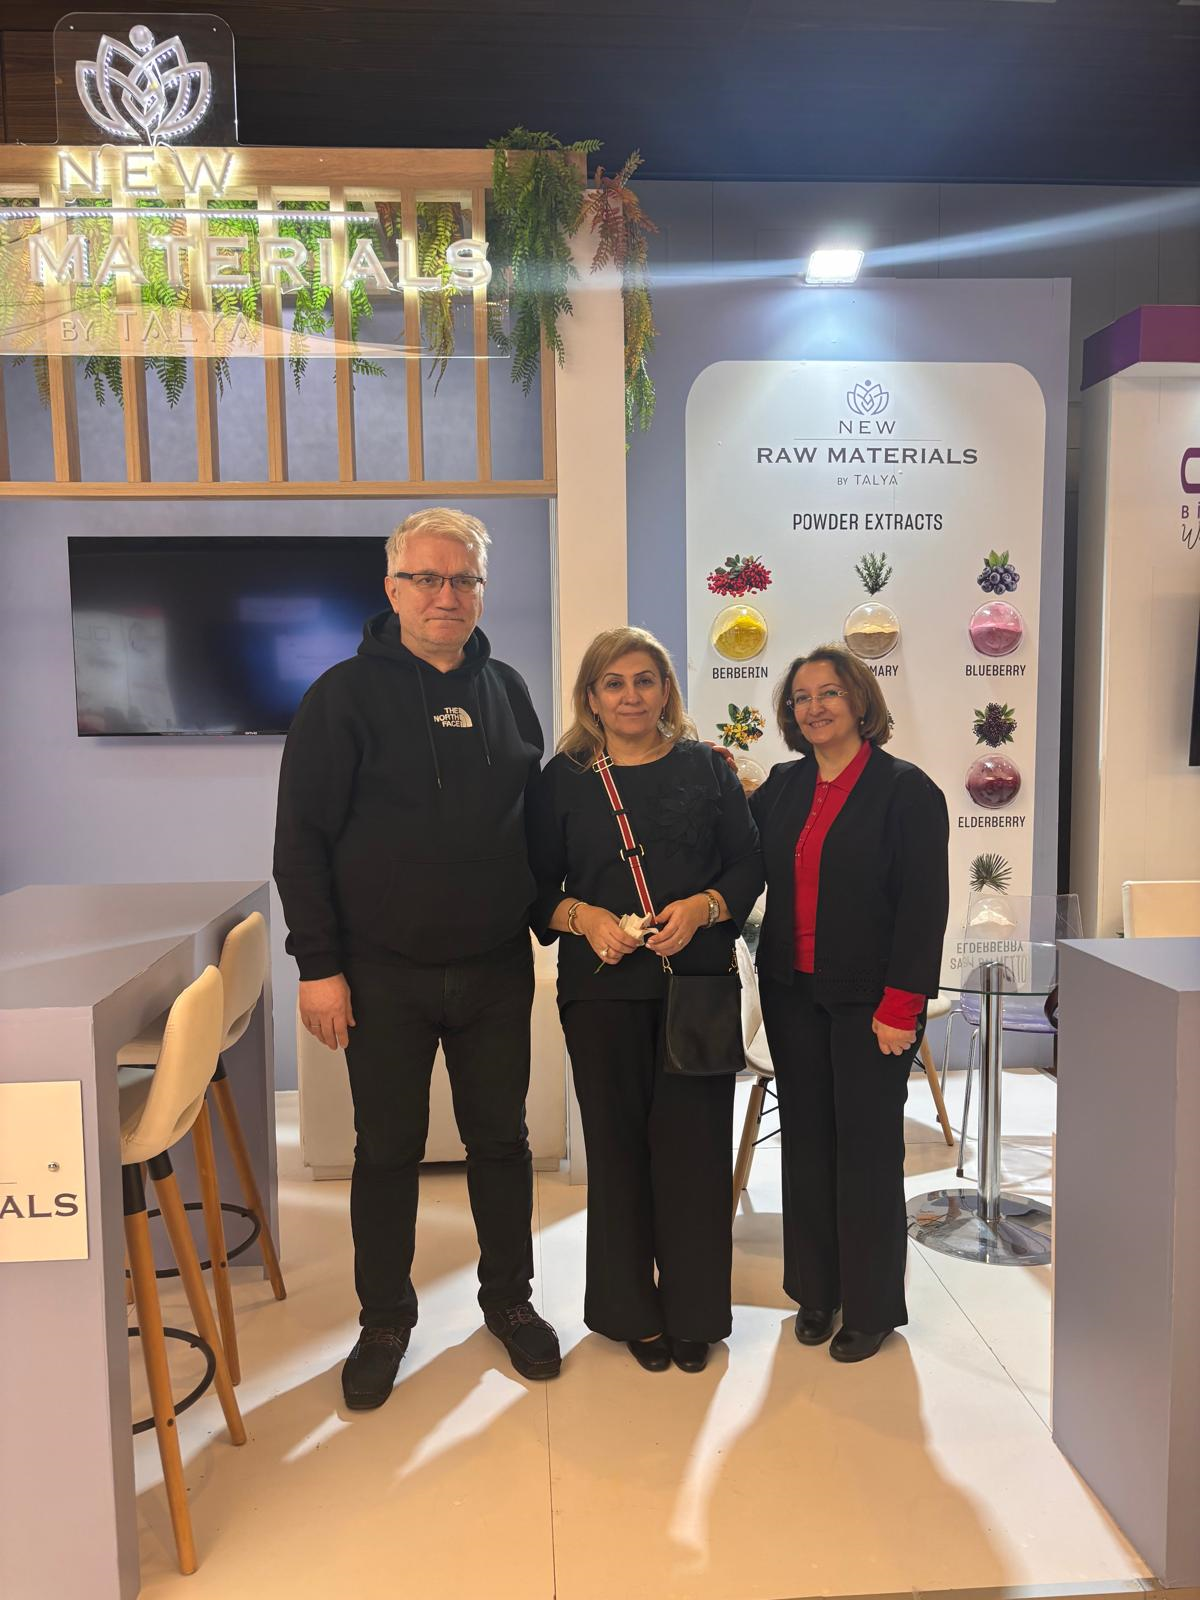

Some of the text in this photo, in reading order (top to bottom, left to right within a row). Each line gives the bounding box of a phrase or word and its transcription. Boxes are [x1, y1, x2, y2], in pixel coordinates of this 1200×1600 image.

[58, 150, 234, 196] NEW
[29, 234, 493, 290] MATERIALS
[60, 309, 260, 344] BY TALYA
[838, 420, 897, 435] NEW
[756, 447, 979, 465] RAW MATERIALS
[837, 474, 899, 486] BY TALYA
[792, 513, 943, 531] POWDER EXTRACTS
[712, 666, 769, 679] BERBERIN
[869, 664, 899, 677] MARY
[965, 664, 1026, 677] BLUEBERRY
[433, 714, 460, 722] NORTH
[958, 816, 1026, 828] ELDERBERRY
